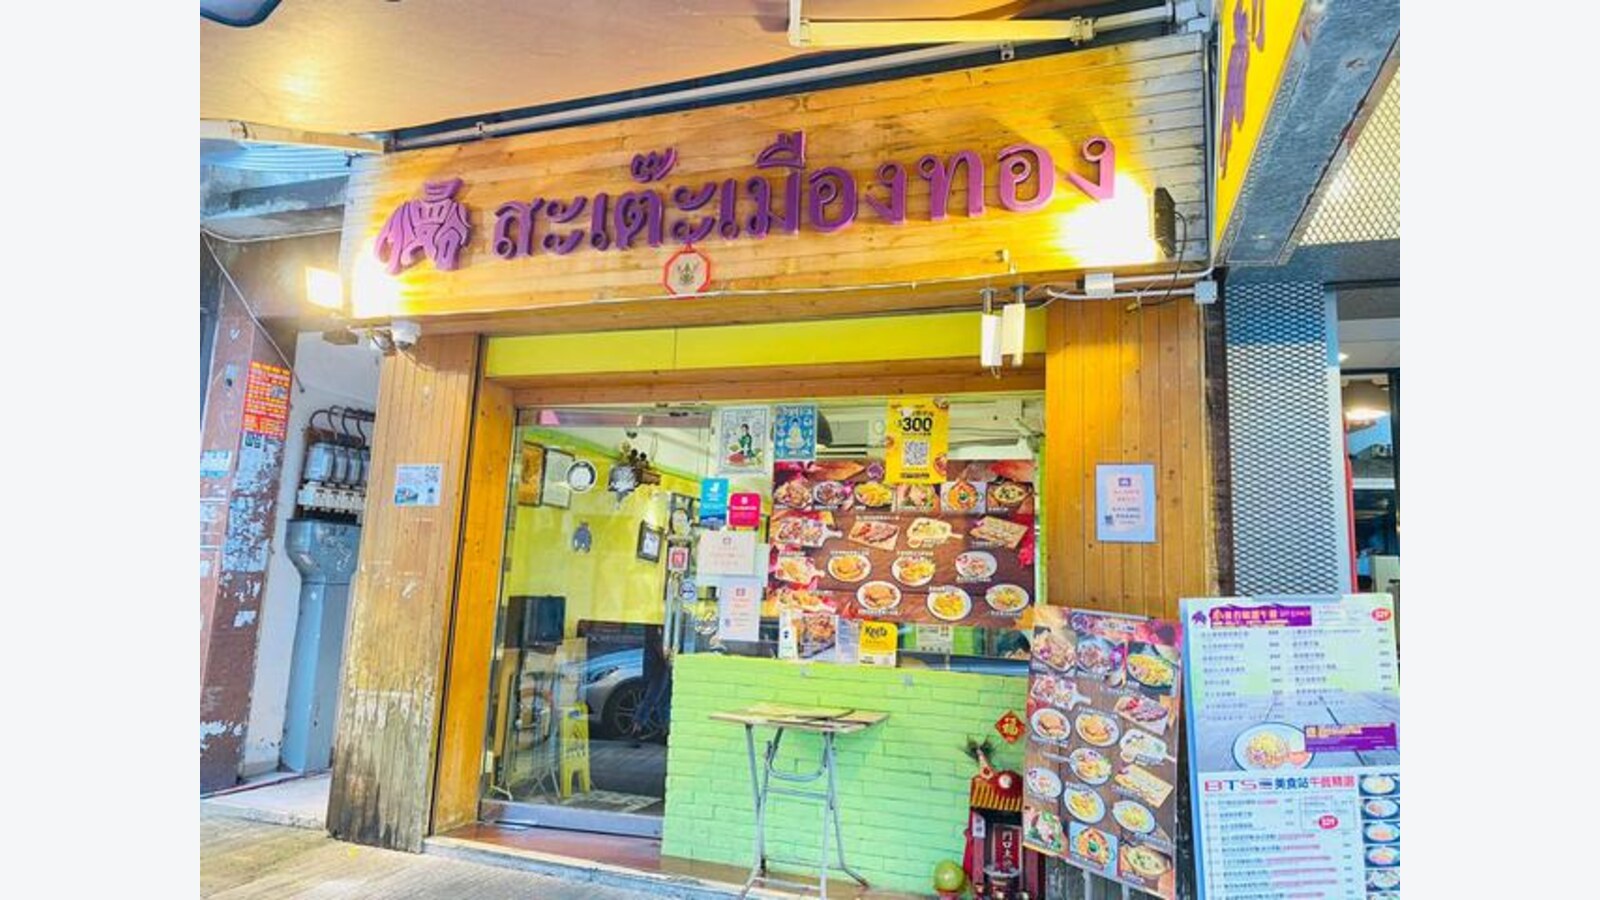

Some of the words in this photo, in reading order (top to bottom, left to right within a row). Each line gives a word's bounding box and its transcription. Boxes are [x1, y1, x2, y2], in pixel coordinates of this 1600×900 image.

[493, 131, 1117, 259] สะเต๊ะเมืองทอง
[1204, 779, 1257, 792] BTS
